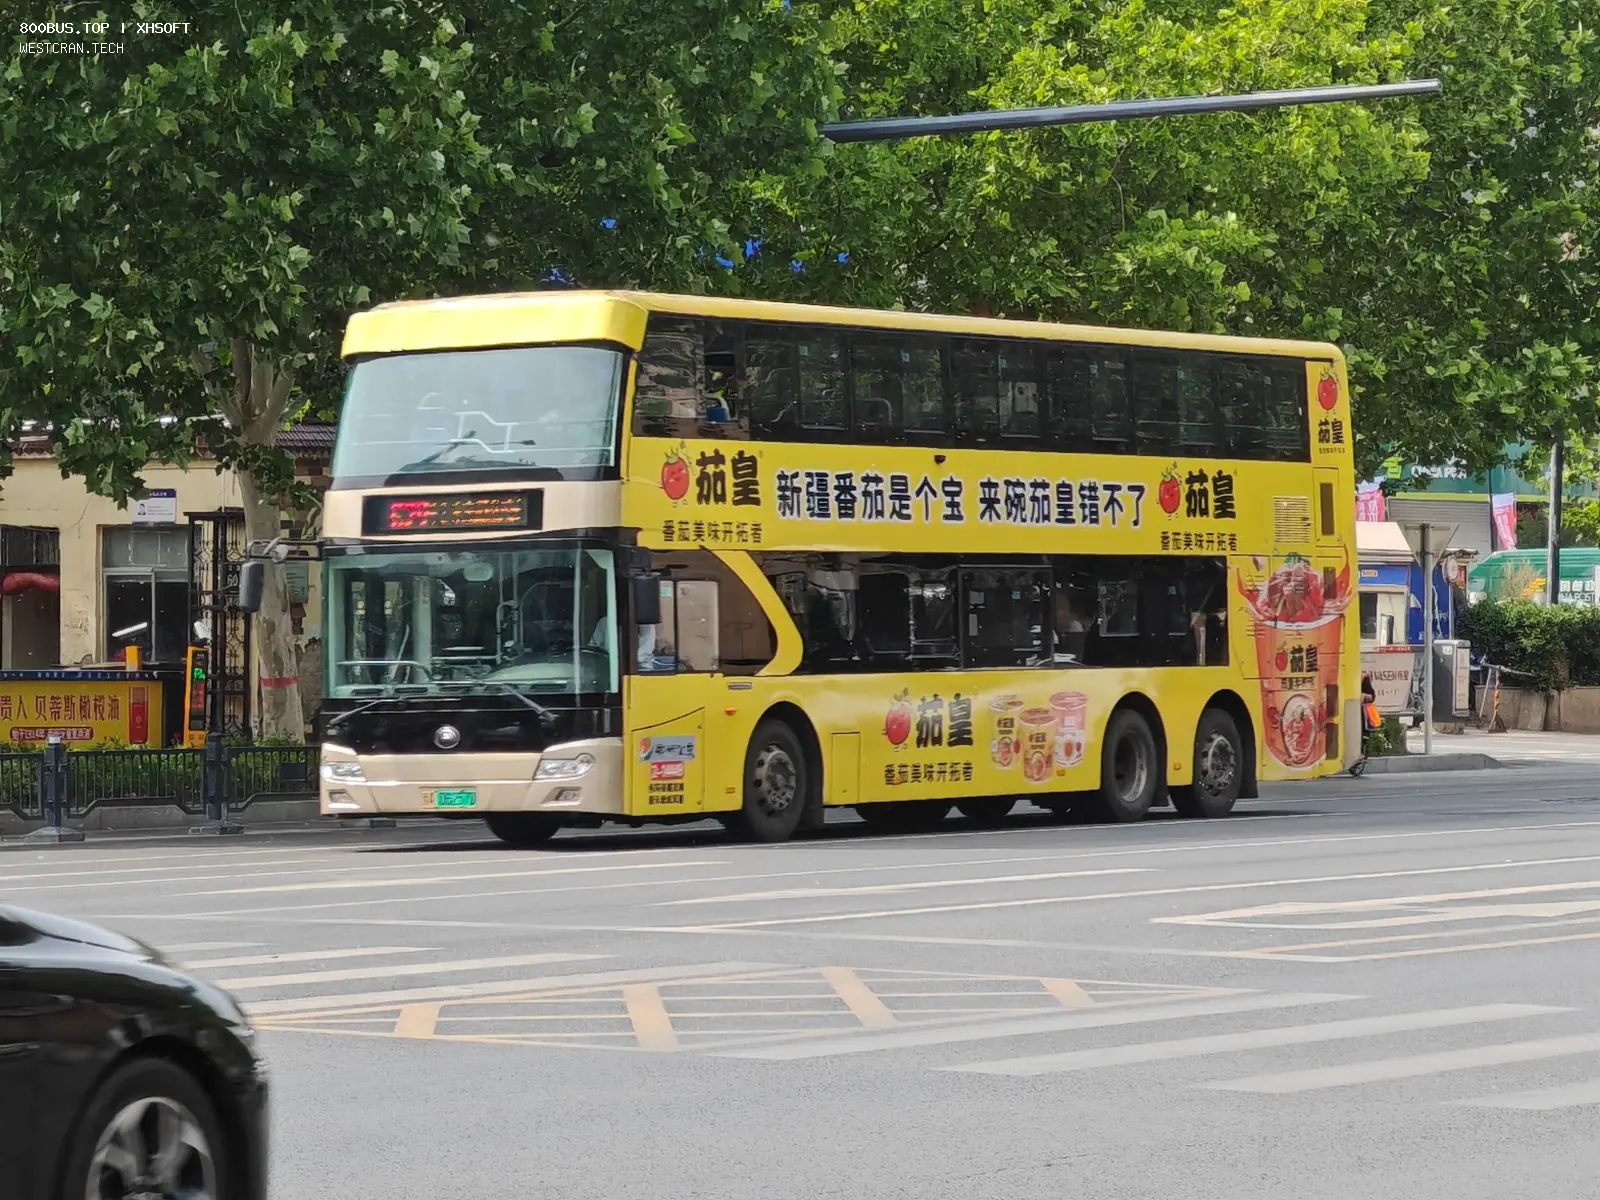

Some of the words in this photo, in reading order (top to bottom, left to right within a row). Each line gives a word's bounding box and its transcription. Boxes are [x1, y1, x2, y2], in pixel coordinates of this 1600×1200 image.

[695, 448, 762, 507] 茄皇
[775, 468, 965, 523] 新疆番茄是个宝
[978, 475, 1147, 528] 来碗茄皇错不了
[1185, 467, 1237, 520] 茄皇
[662, 519, 764, 544] 番茄美味开拓者
[1160, 530, 1238, 552] 番茄美味开拓者
[915, 692, 974, 748] 茄皇
[884, 760, 975, 786] 番茄美味开拓者
